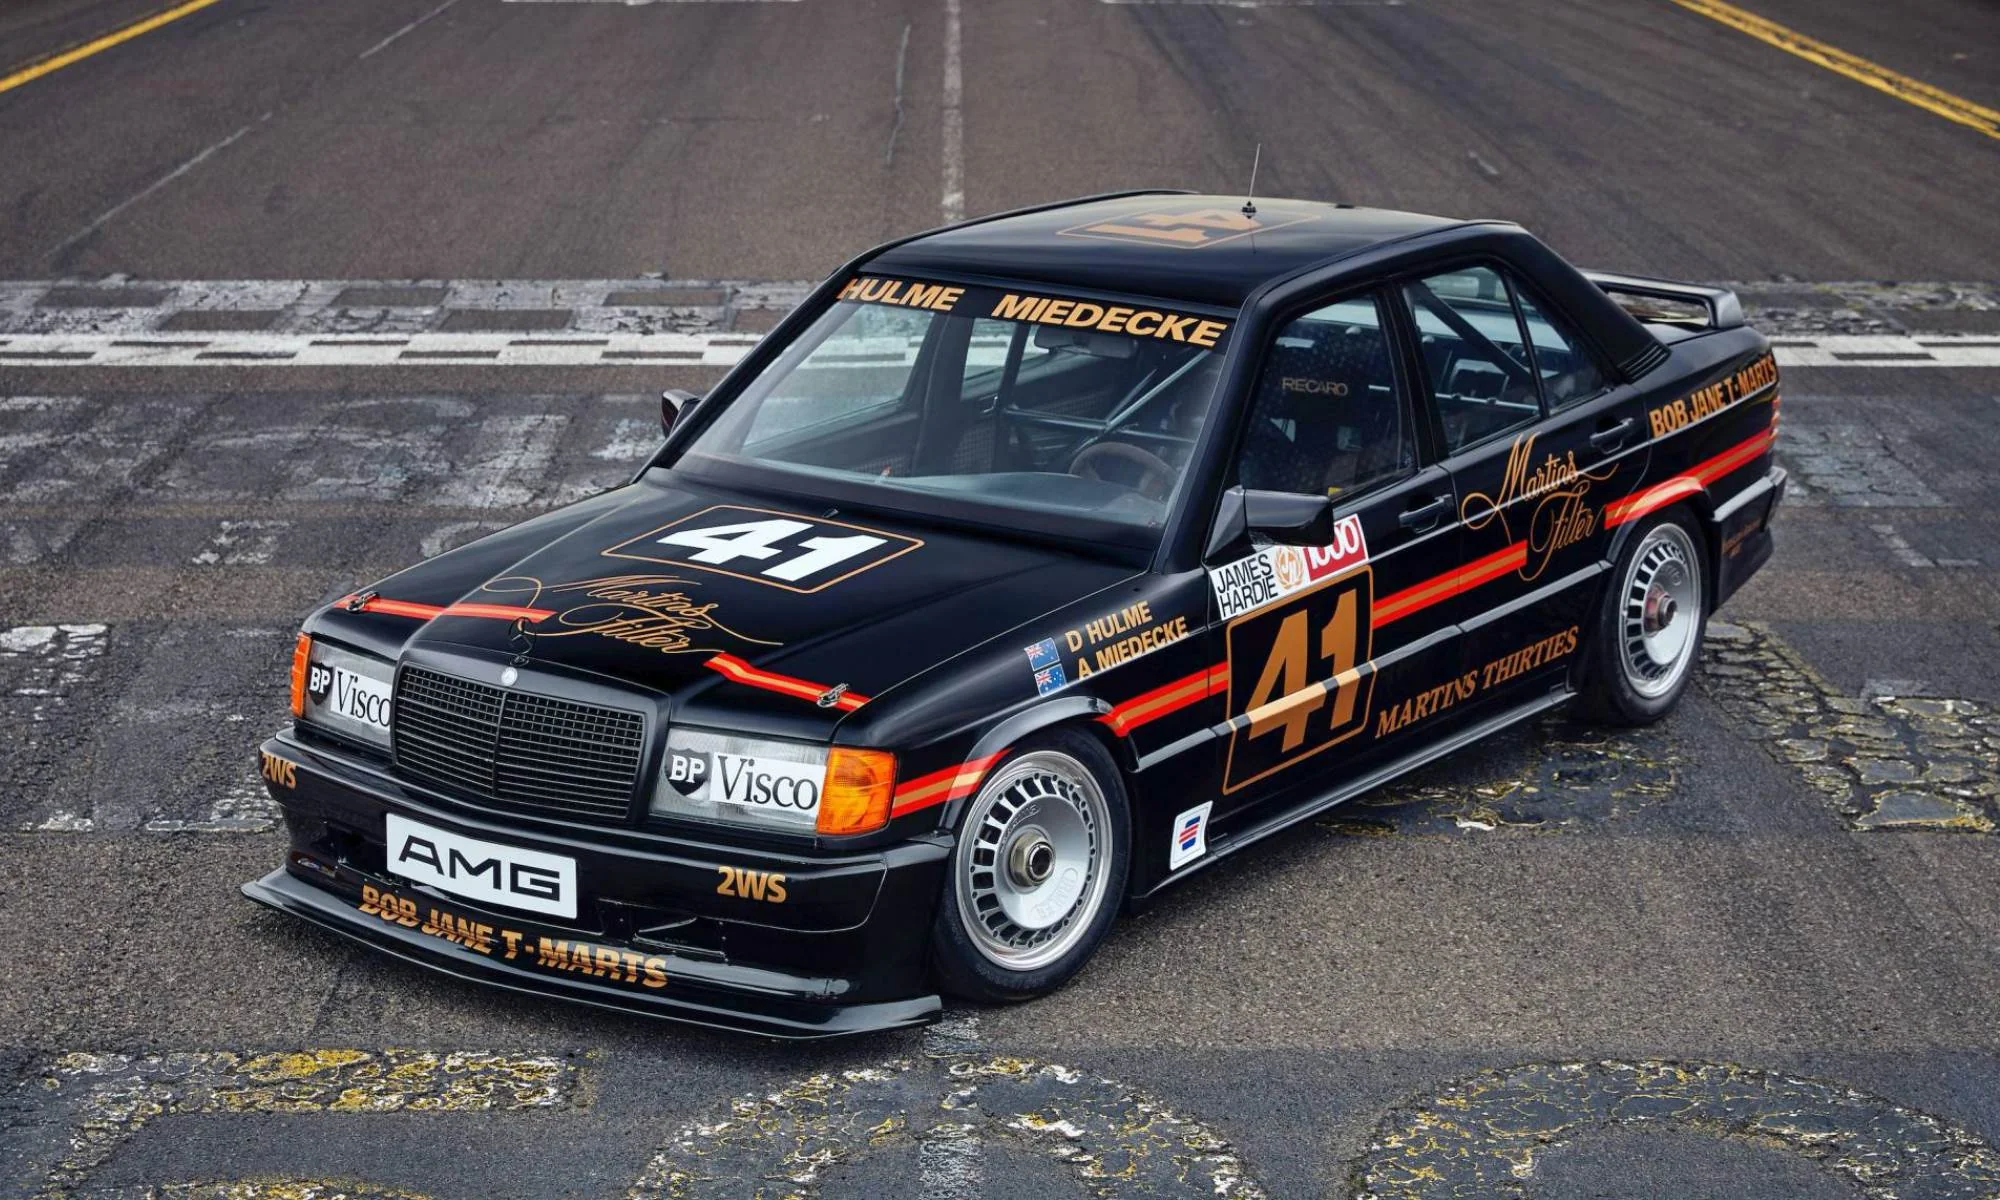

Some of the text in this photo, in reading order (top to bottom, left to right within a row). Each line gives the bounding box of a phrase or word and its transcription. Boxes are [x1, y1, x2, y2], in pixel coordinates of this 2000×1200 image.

[836, 278, 1228, 348] HULME MIEDECKE
[1281, 377, 1348, 397] RECARO
[1650, 400, 1688, 439] BOB
[1690, 383, 1726, 422] JANE
[656, 518, 889, 582] 41
[1523, 480, 1600, 565] Filter
[1217, 553, 1273, 594] JAMES
[1219, 574, 1279, 618] HARDIE
[545, 602, 718, 654] Filter
[1065, 601, 1153, 653] D HULME
[1077, 616, 1190, 682] A MIEDECKE
[309, 664, 332, 694] BP
[1248, 588, 1361, 753] 41
[1375, 625, 1580, 741] MARTINS THIRTIES
[337, 670, 392, 728] Visco
[262, 754, 297, 789] 2WS
[669, 754, 706, 784] BP
[717, 755, 818, 811] Visco
[399, 834, 560, 902] AMG
[716, 866, 788, 904] 2WS
[358, 885, 419, 927] BOB
[421, 908, 497, 955] JANE
